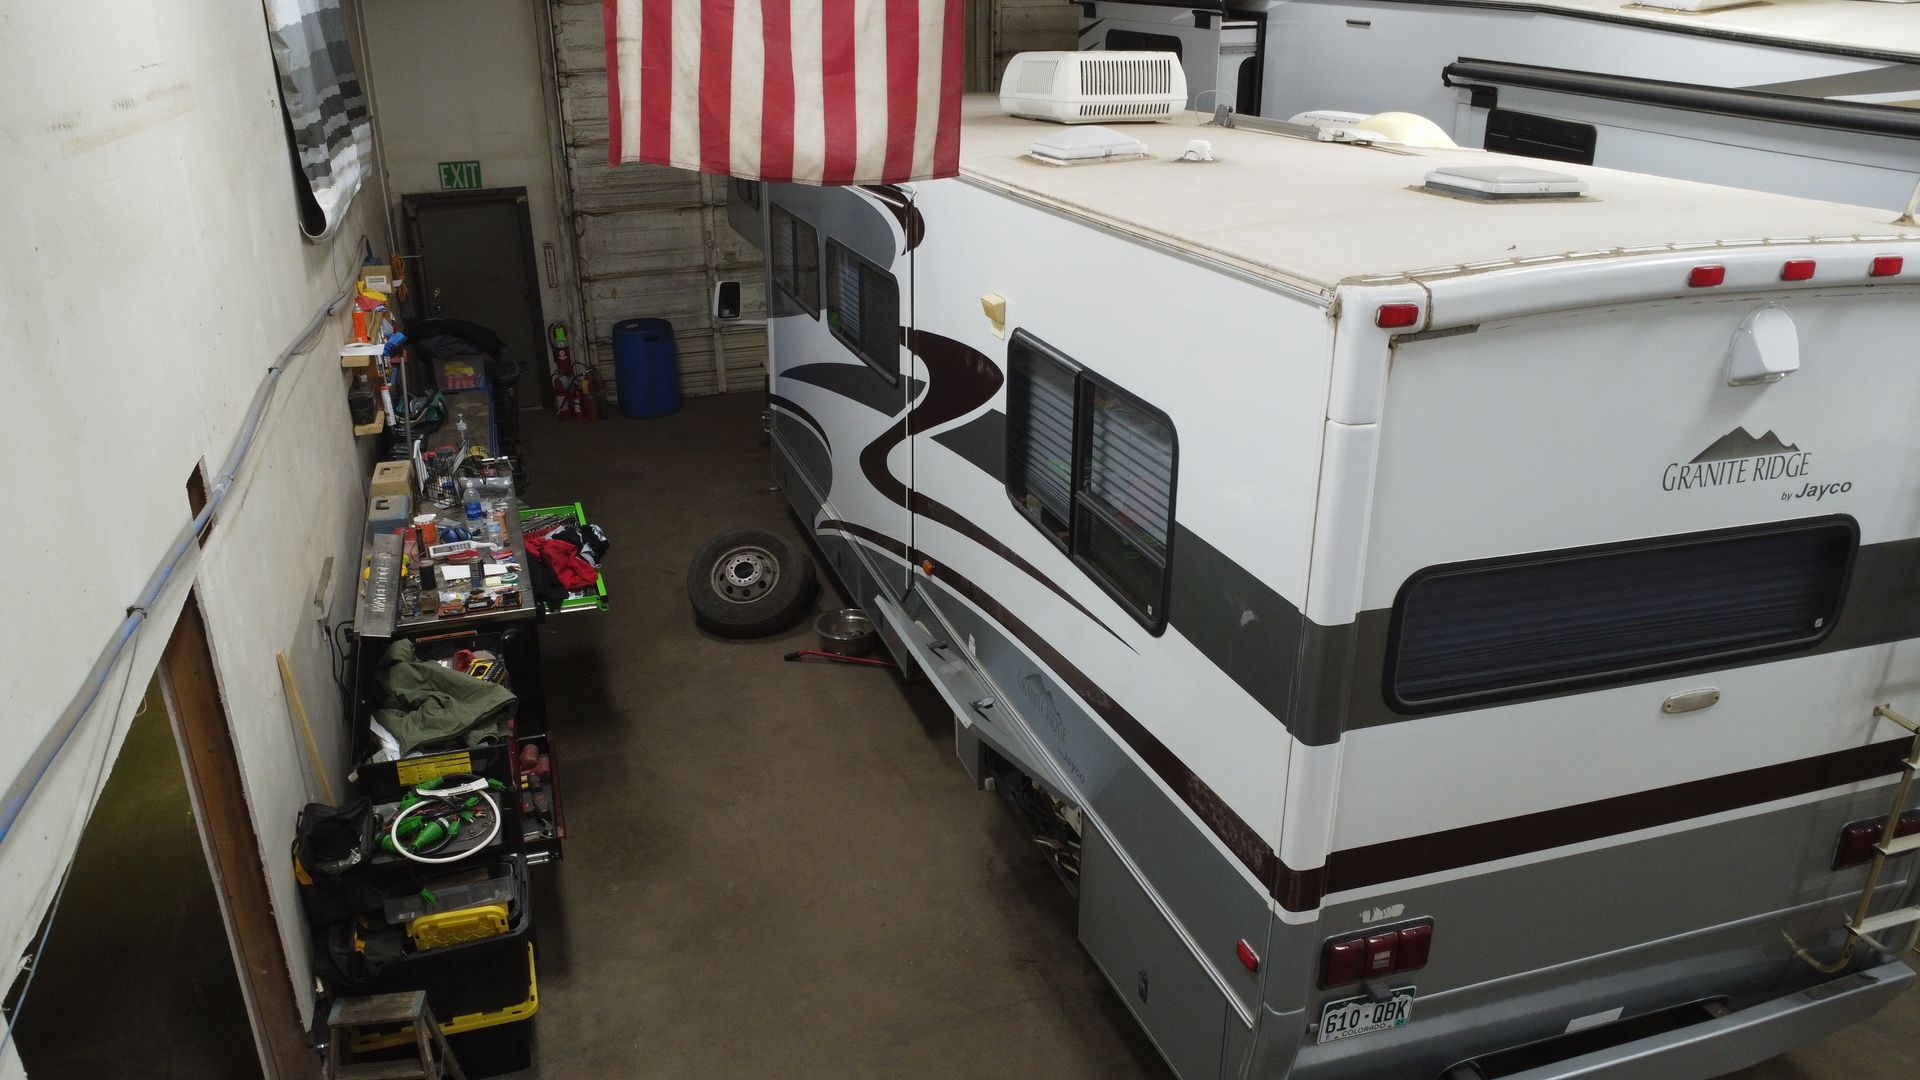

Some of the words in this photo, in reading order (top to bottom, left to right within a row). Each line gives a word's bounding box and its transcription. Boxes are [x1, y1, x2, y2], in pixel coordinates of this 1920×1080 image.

[440, 163, 478, 189] EXIT
[1662, 459, 1749, 492] GRANITE
[1752, 452, 1812, 482] RIDGE
[1781, 491, 1793, 501] by
[1795, 481, 1852, 501] Jayco
[1341, 1022, 1386, 1036] COLORADO
